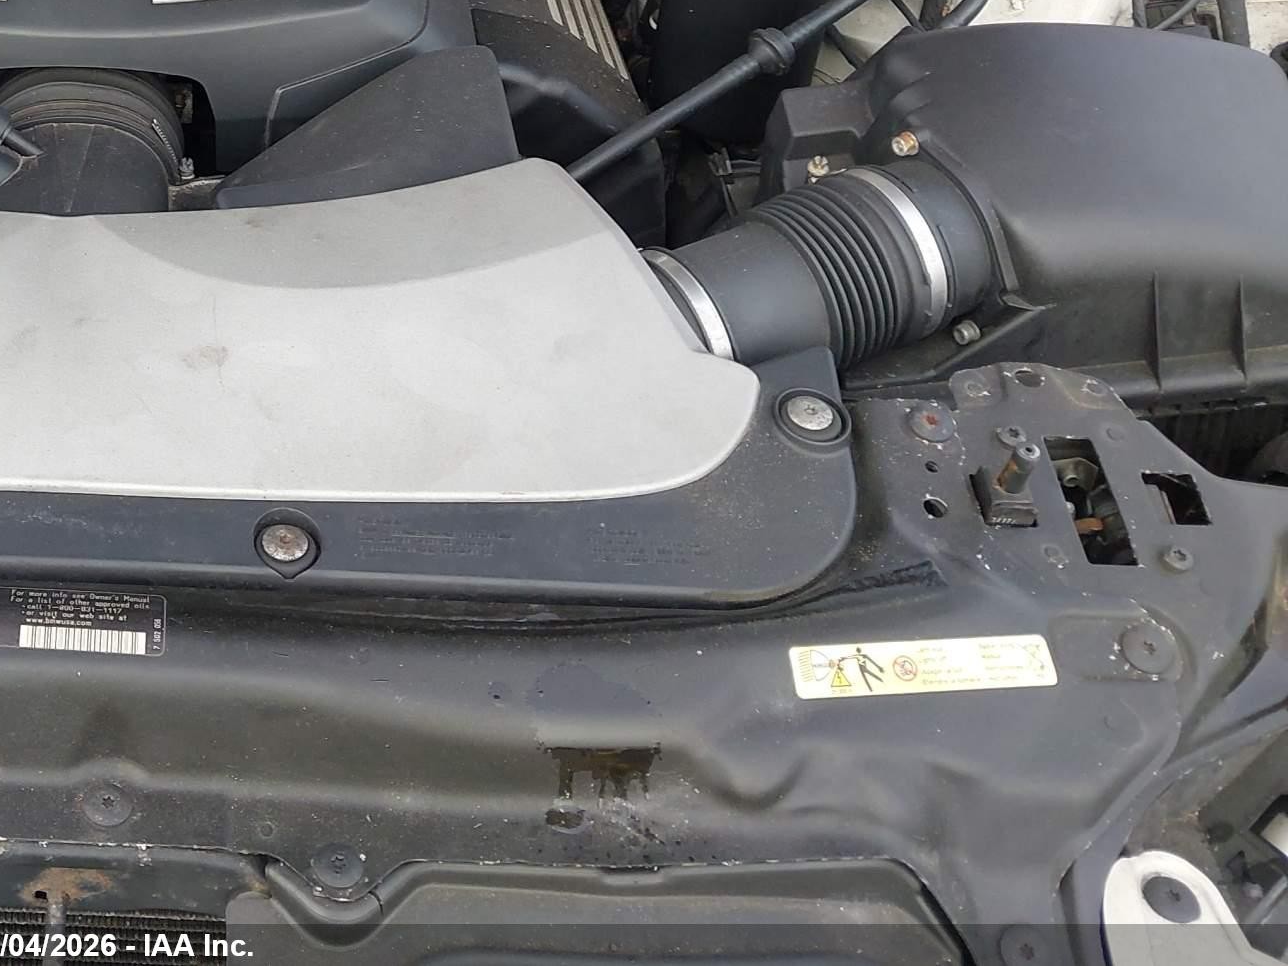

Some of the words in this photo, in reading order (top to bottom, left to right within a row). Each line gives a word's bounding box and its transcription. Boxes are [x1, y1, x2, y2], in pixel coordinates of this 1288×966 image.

[10, 595, 23, 603] For
[69, 598, 90, 606] other
[94, 600, 130, 609] approved
[89, 593, 120, 601] Owner's
[123, 595, 150, 603] Manual
